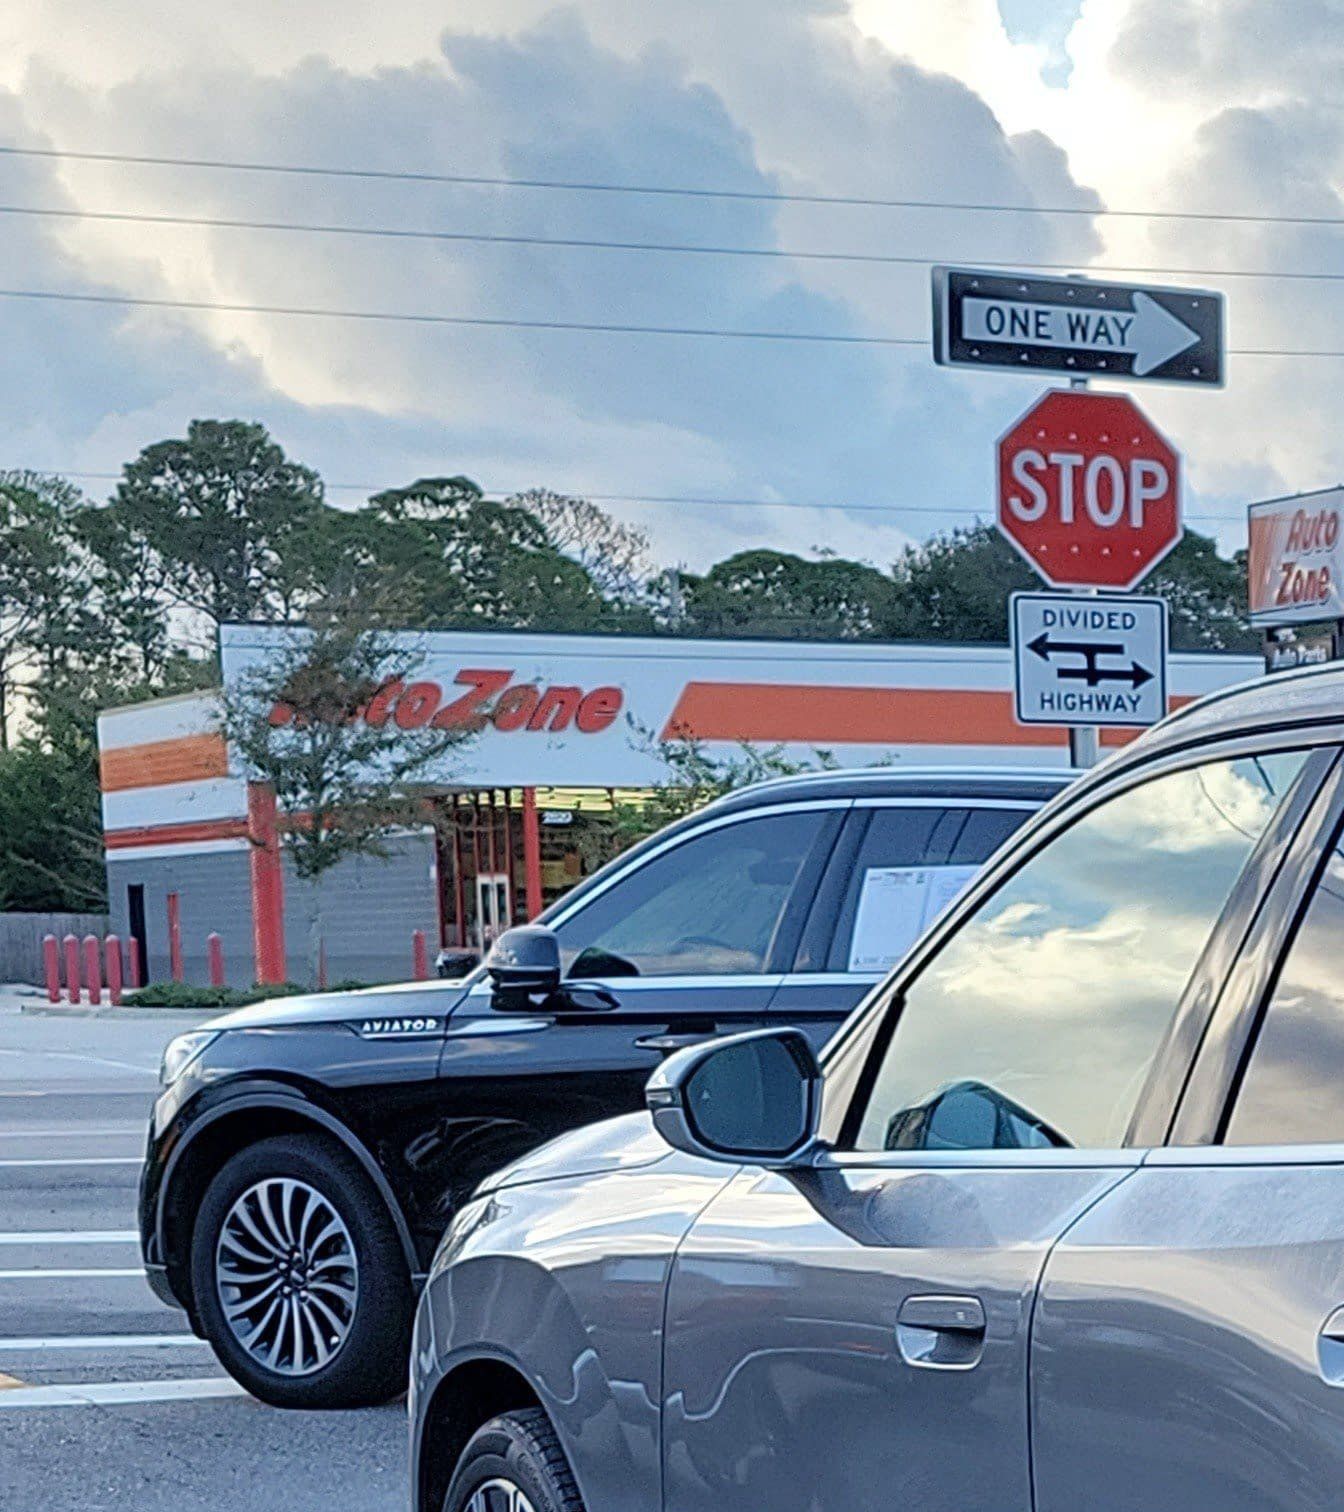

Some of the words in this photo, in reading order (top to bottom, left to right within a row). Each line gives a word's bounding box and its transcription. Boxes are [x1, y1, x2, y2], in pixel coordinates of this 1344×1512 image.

[985, 306, 1052, 339] ONE
[1067, 313, 1133, 347] WAY
[1008, 449, 1169, 528] STOP
[1285, 509, 1340, 553] Auto
[1275, 561, 1331, 606] Zone
[1042, 609, 1136, 630] DIVIDED
[268, 668, 624, 734] toZone
[1040, 692, 1141, 713] HIGHWAY
[362, 1018, 437, 1032] AVIATOR
